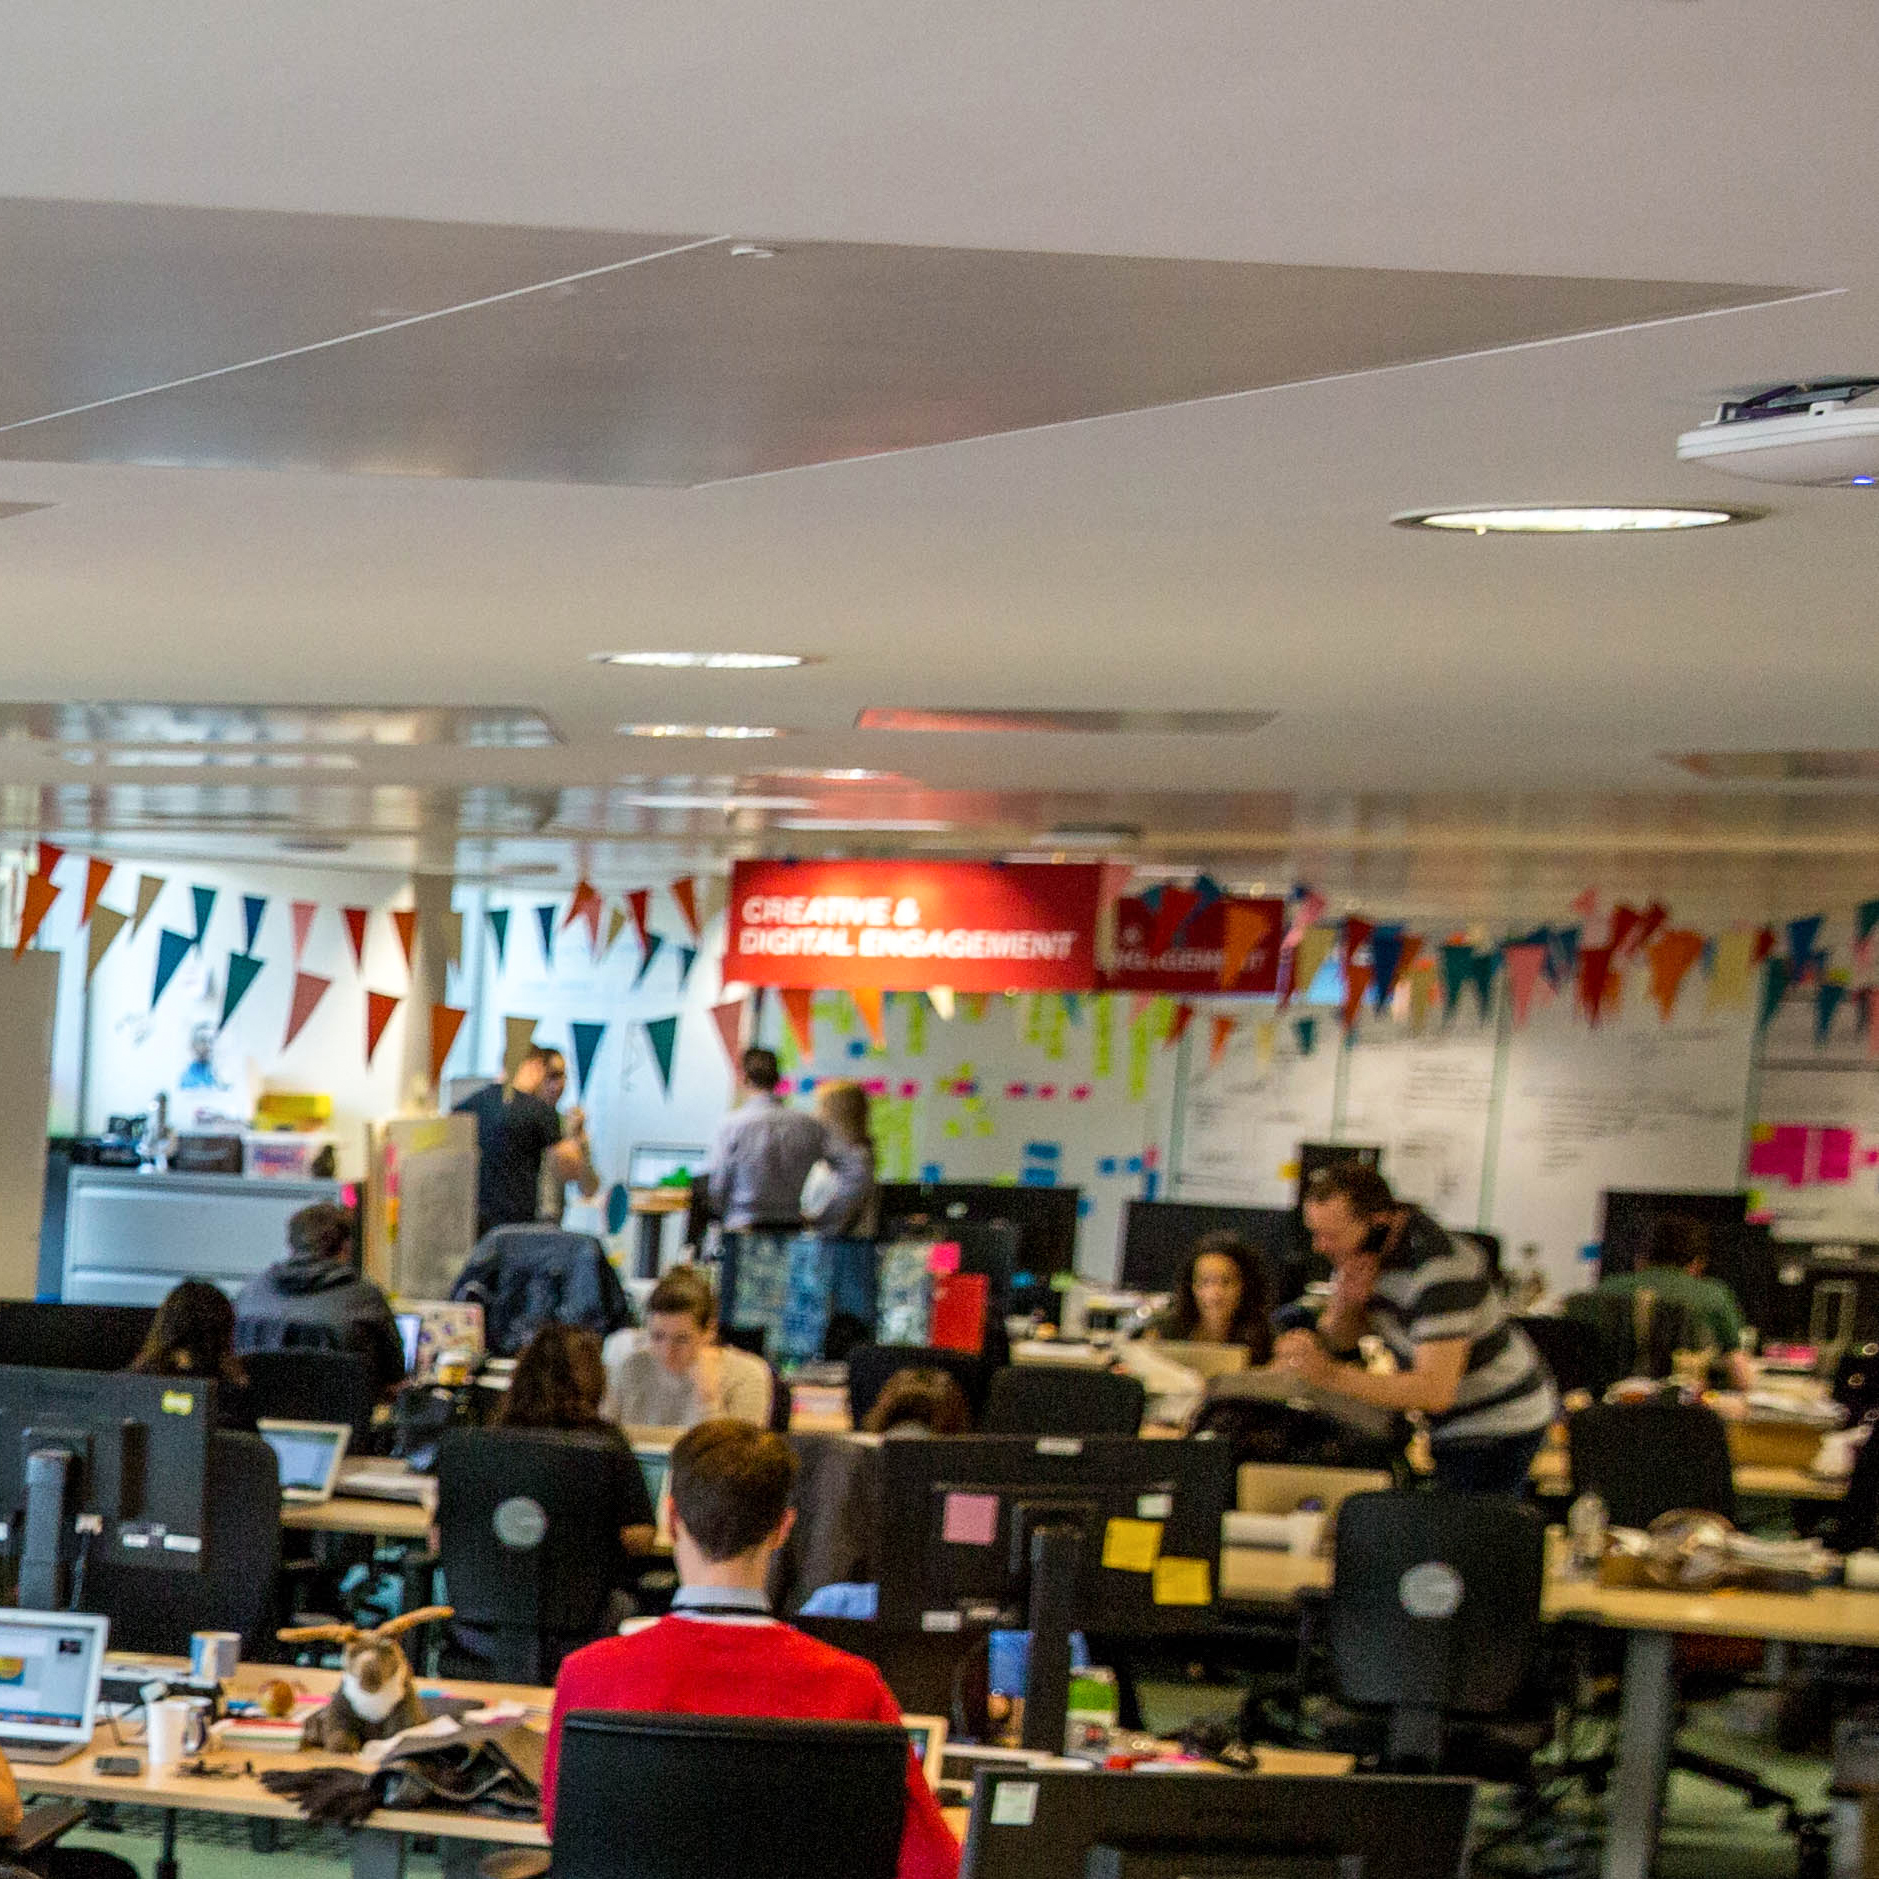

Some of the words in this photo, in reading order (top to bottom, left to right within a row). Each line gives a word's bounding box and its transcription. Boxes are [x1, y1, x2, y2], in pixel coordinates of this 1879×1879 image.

[742, 894, 891, 926] CREATIVE
[893, 896, 920, 926] &
[739, 927, 856, 957] DIGITAL
[859, 929, 1077, 960] ENGAGEMENT
